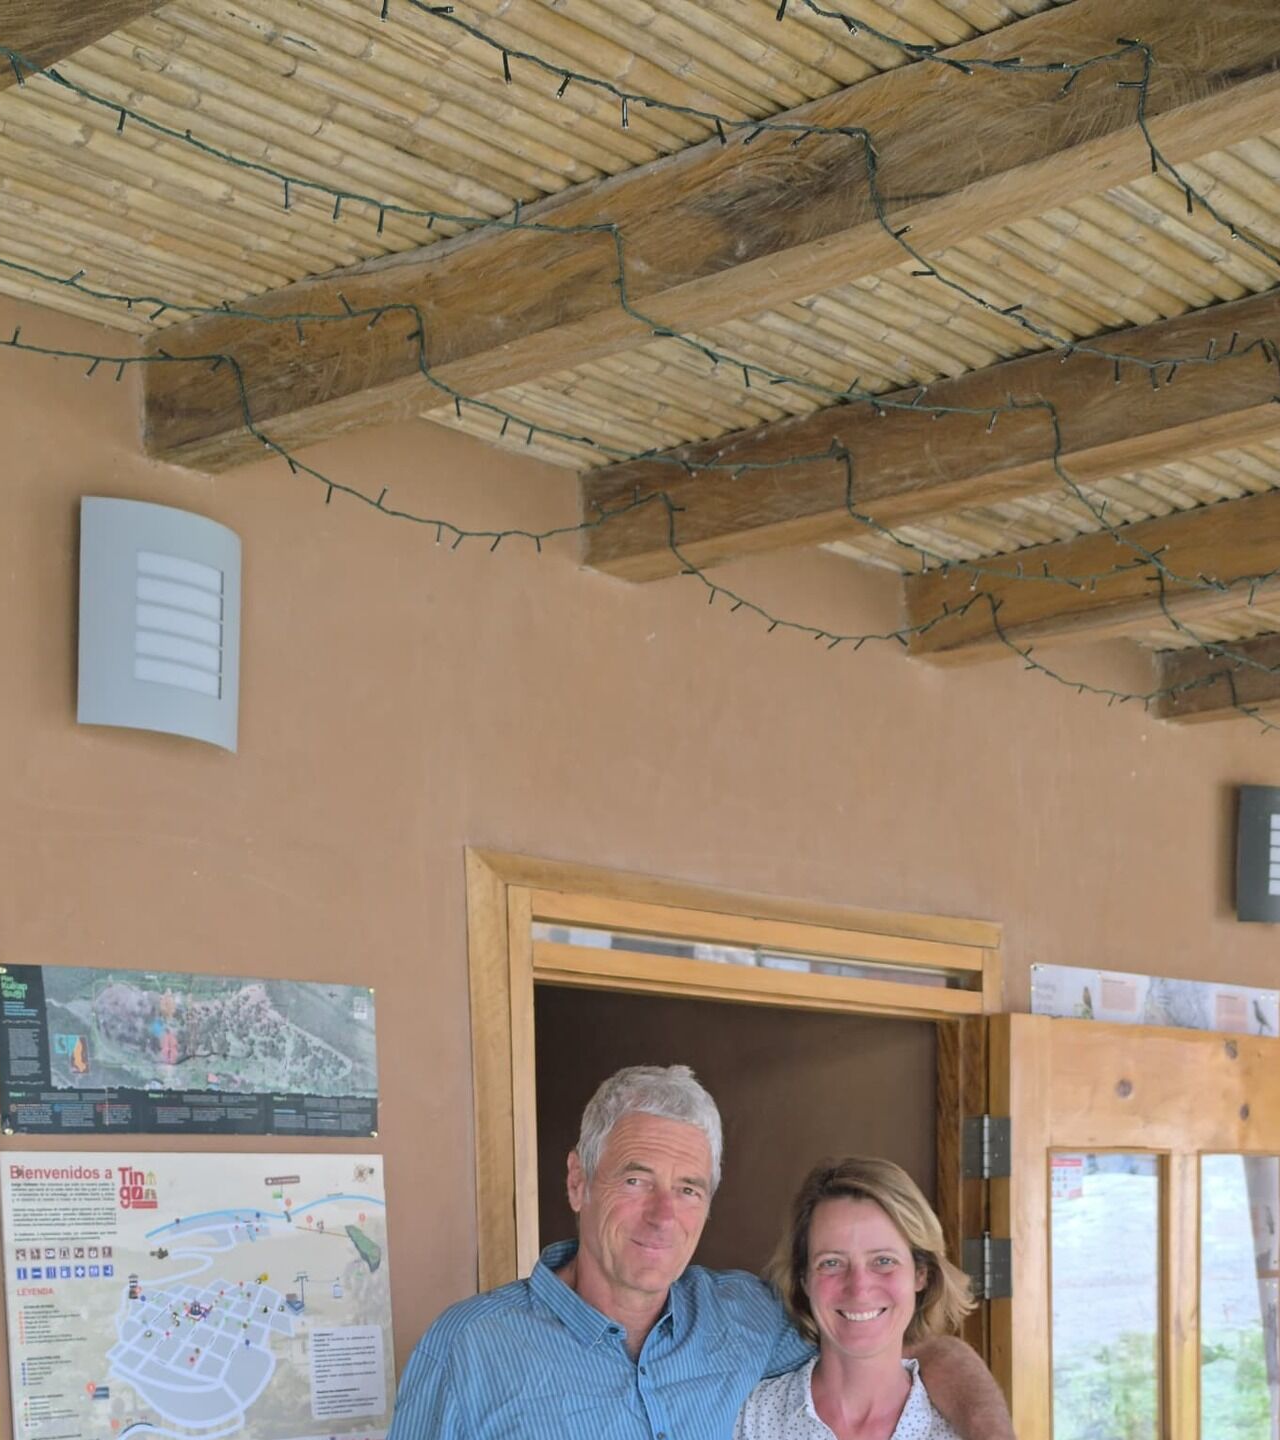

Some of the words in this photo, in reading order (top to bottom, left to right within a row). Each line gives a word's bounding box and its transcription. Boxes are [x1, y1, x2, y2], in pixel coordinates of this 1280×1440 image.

[10, 1165, 100, 1180] Bienvenidos
[104, 1168, 113, 1180] a
[16, 1286, 55, 1297] LEYENDA
